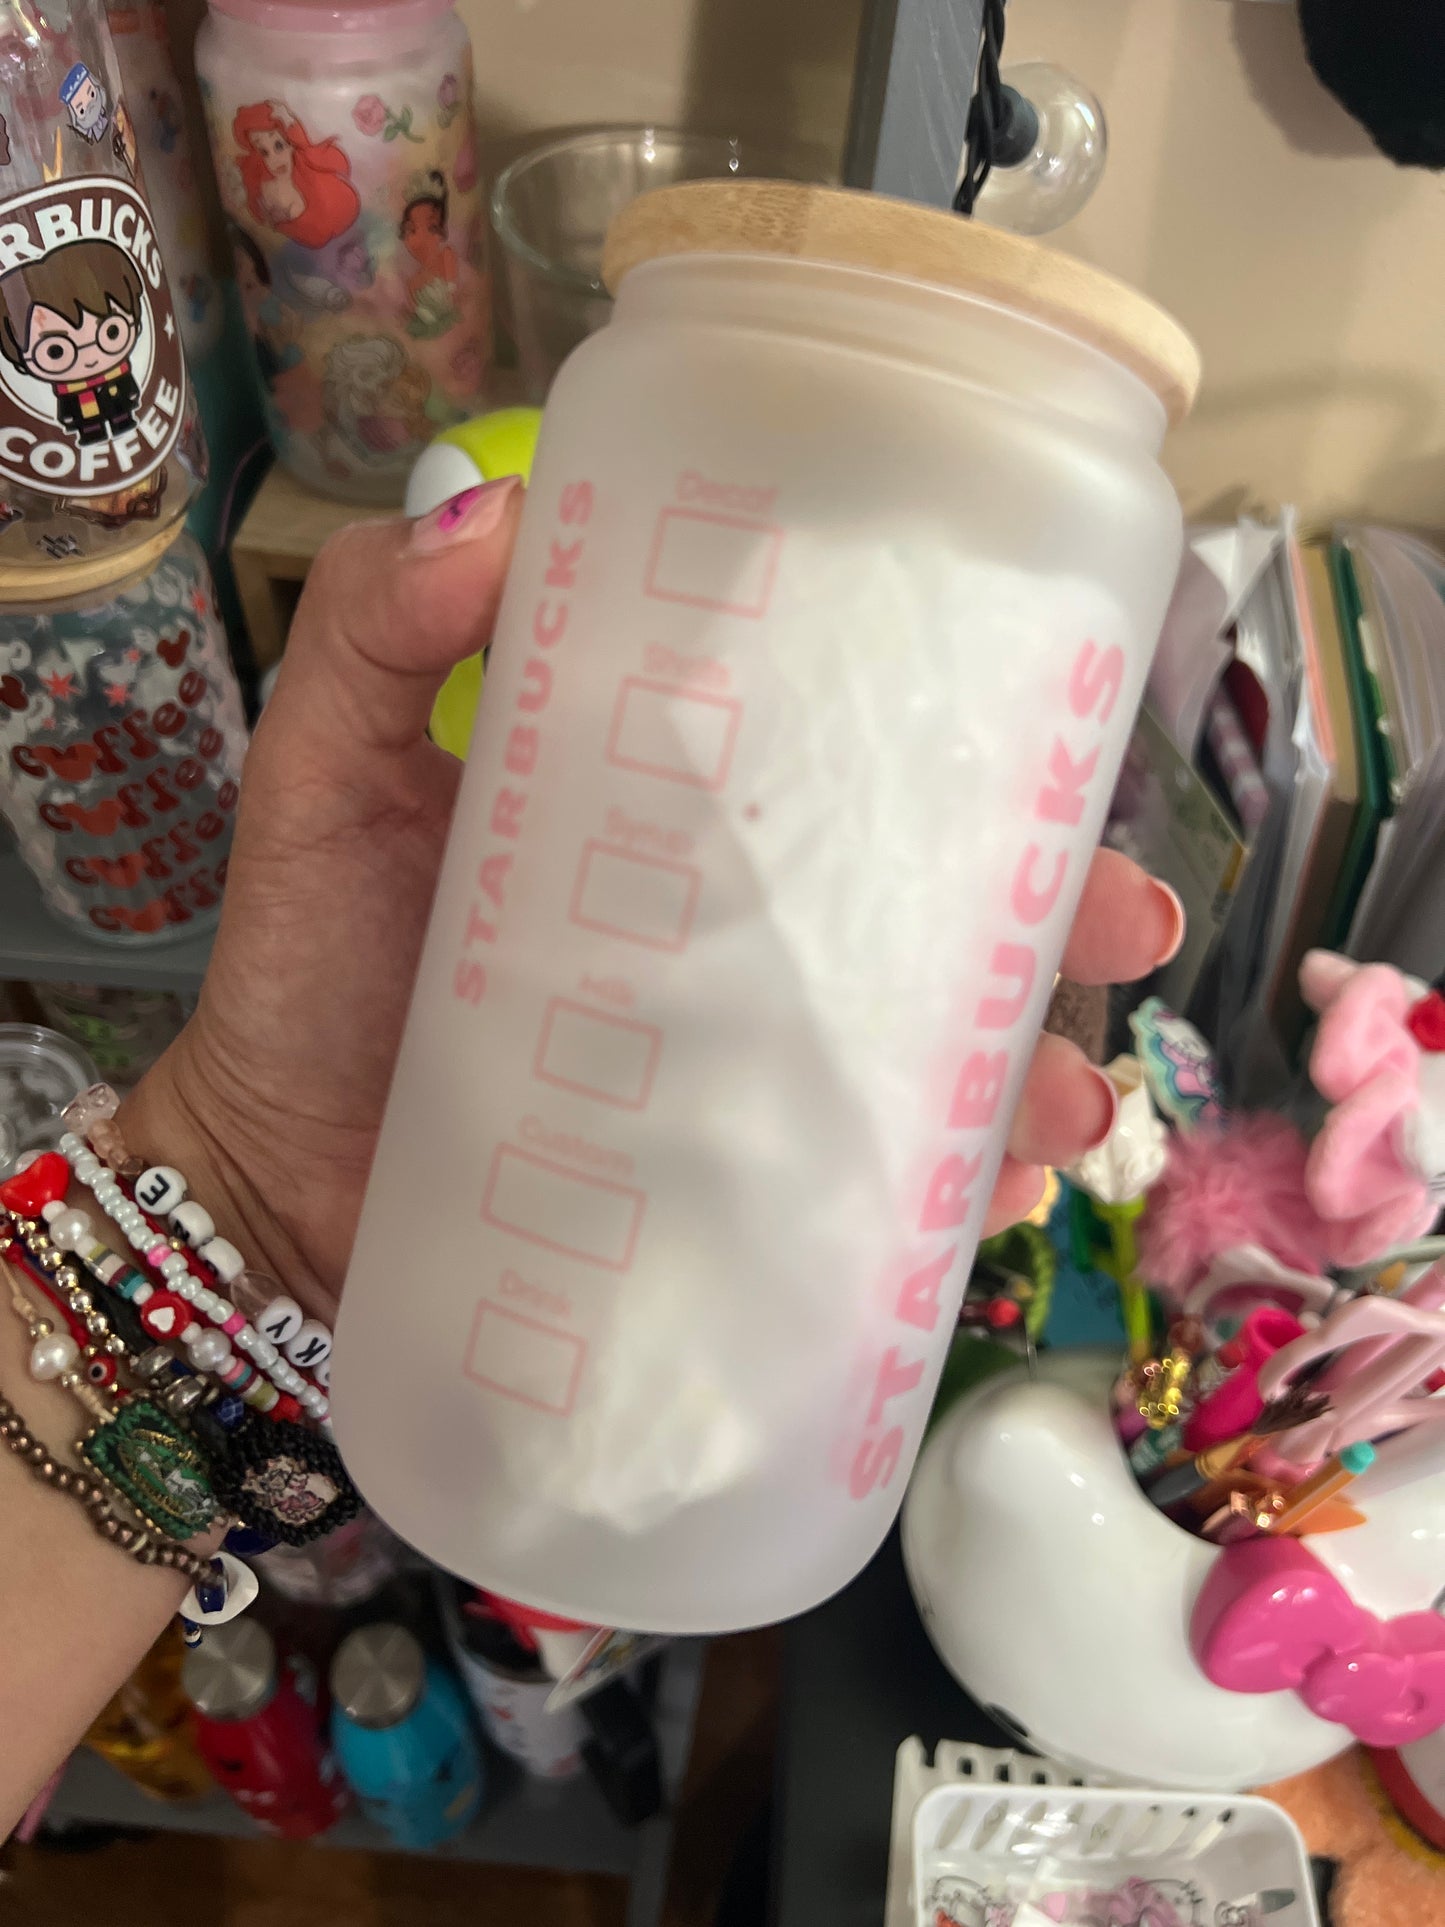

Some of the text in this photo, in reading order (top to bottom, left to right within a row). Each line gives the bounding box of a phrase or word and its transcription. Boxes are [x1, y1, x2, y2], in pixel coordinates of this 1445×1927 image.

[0, 376, 178, 481] COFFEE
[454, 480, 594, 1007] STARBUCKS
[848, 639, 1125, 1500] STARBUCKS
